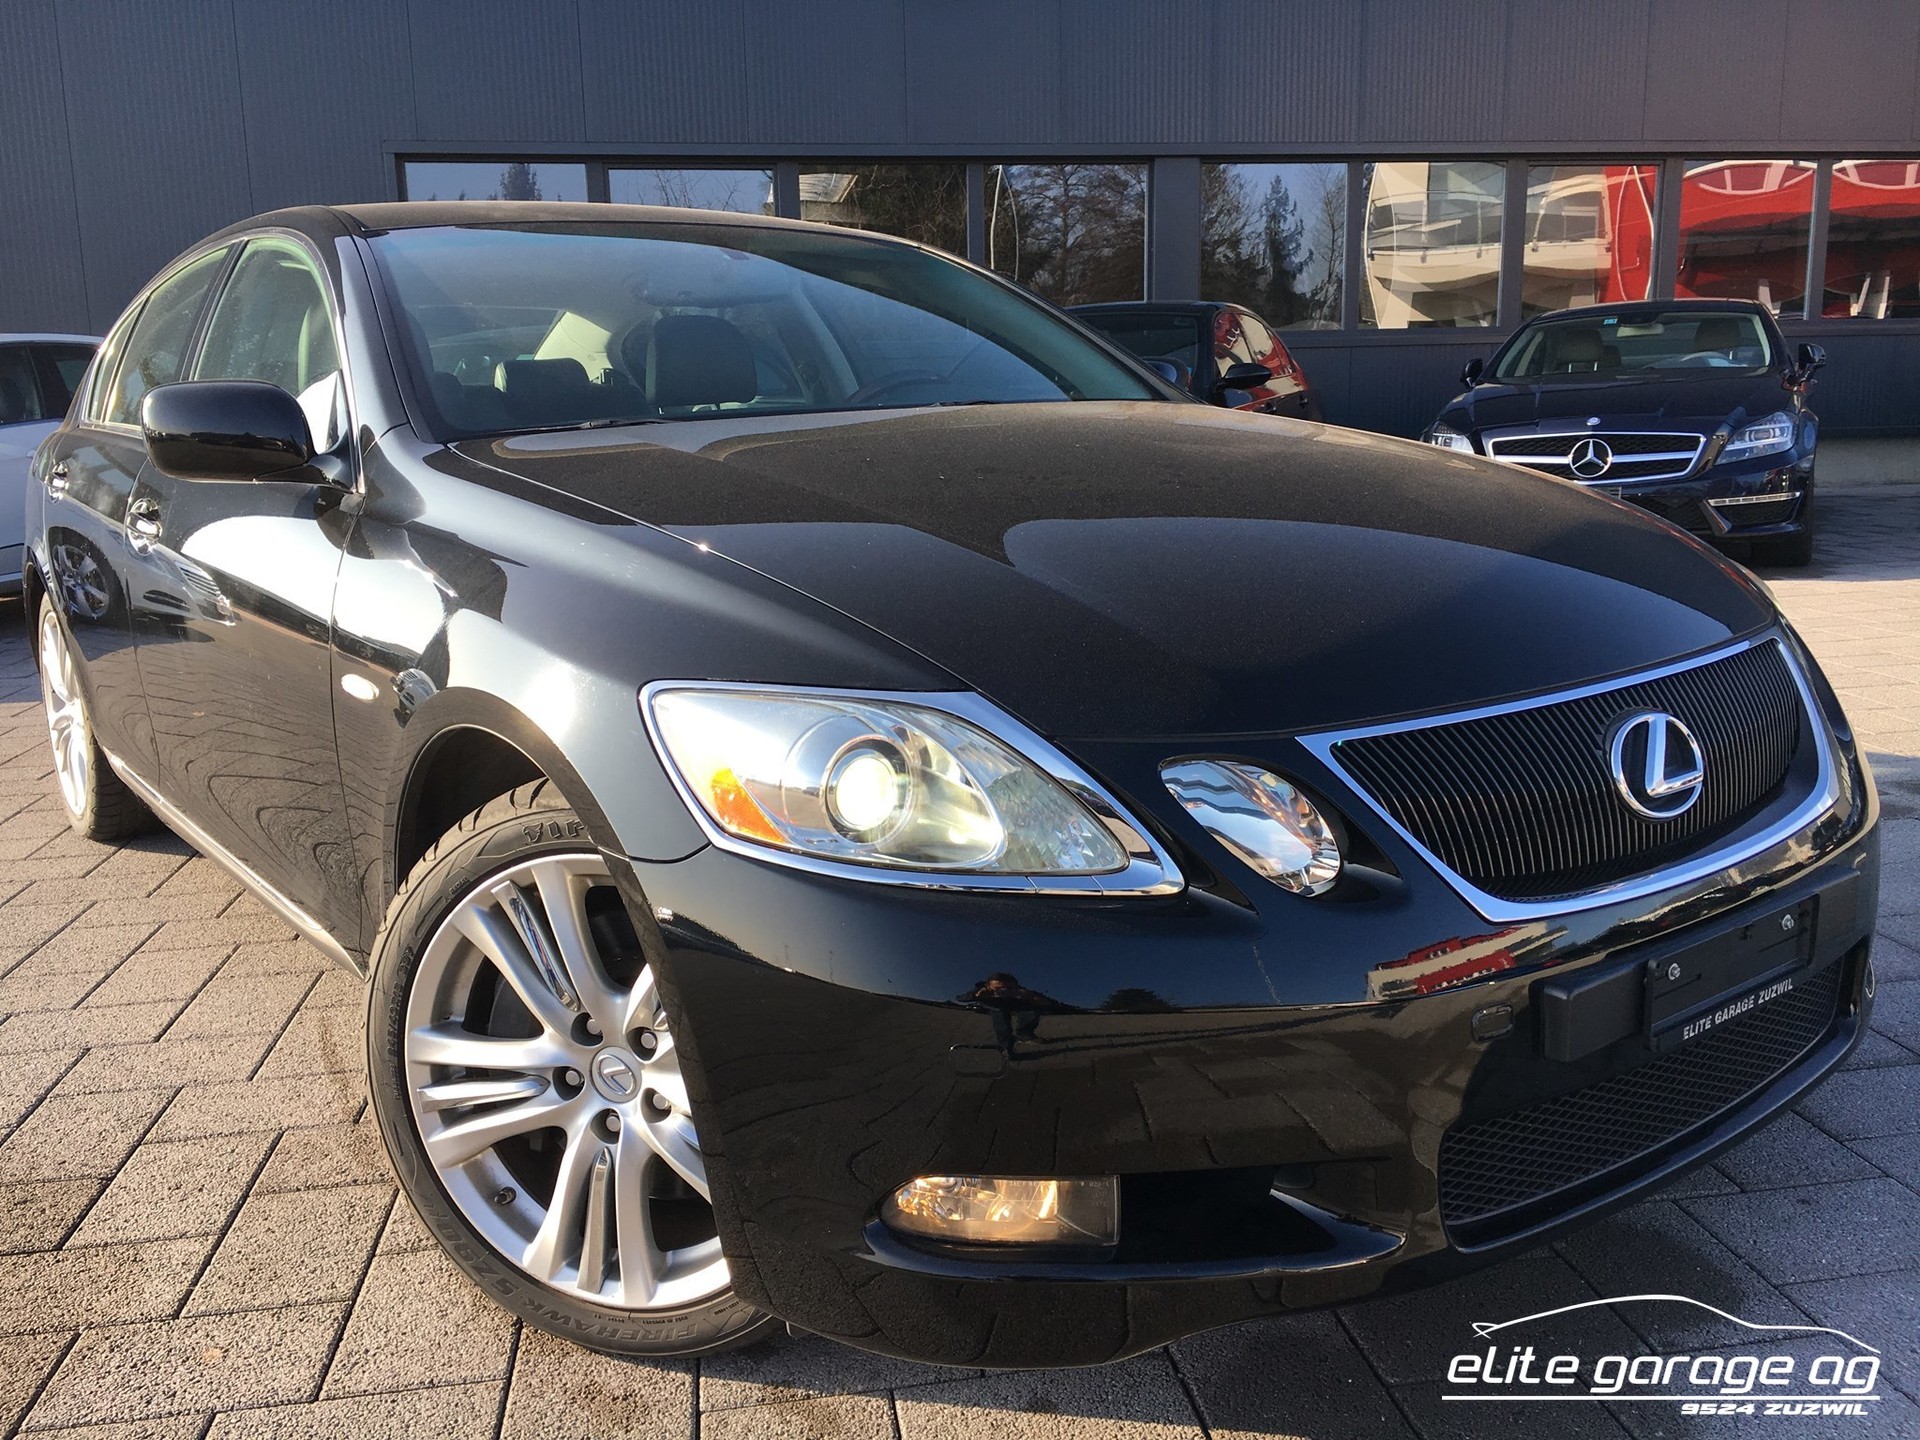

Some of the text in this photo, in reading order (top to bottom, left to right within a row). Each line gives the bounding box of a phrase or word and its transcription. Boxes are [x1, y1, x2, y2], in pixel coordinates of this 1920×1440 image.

[1682, 978, 1793, 1041] ELITE GARAGE ZUZWIL
